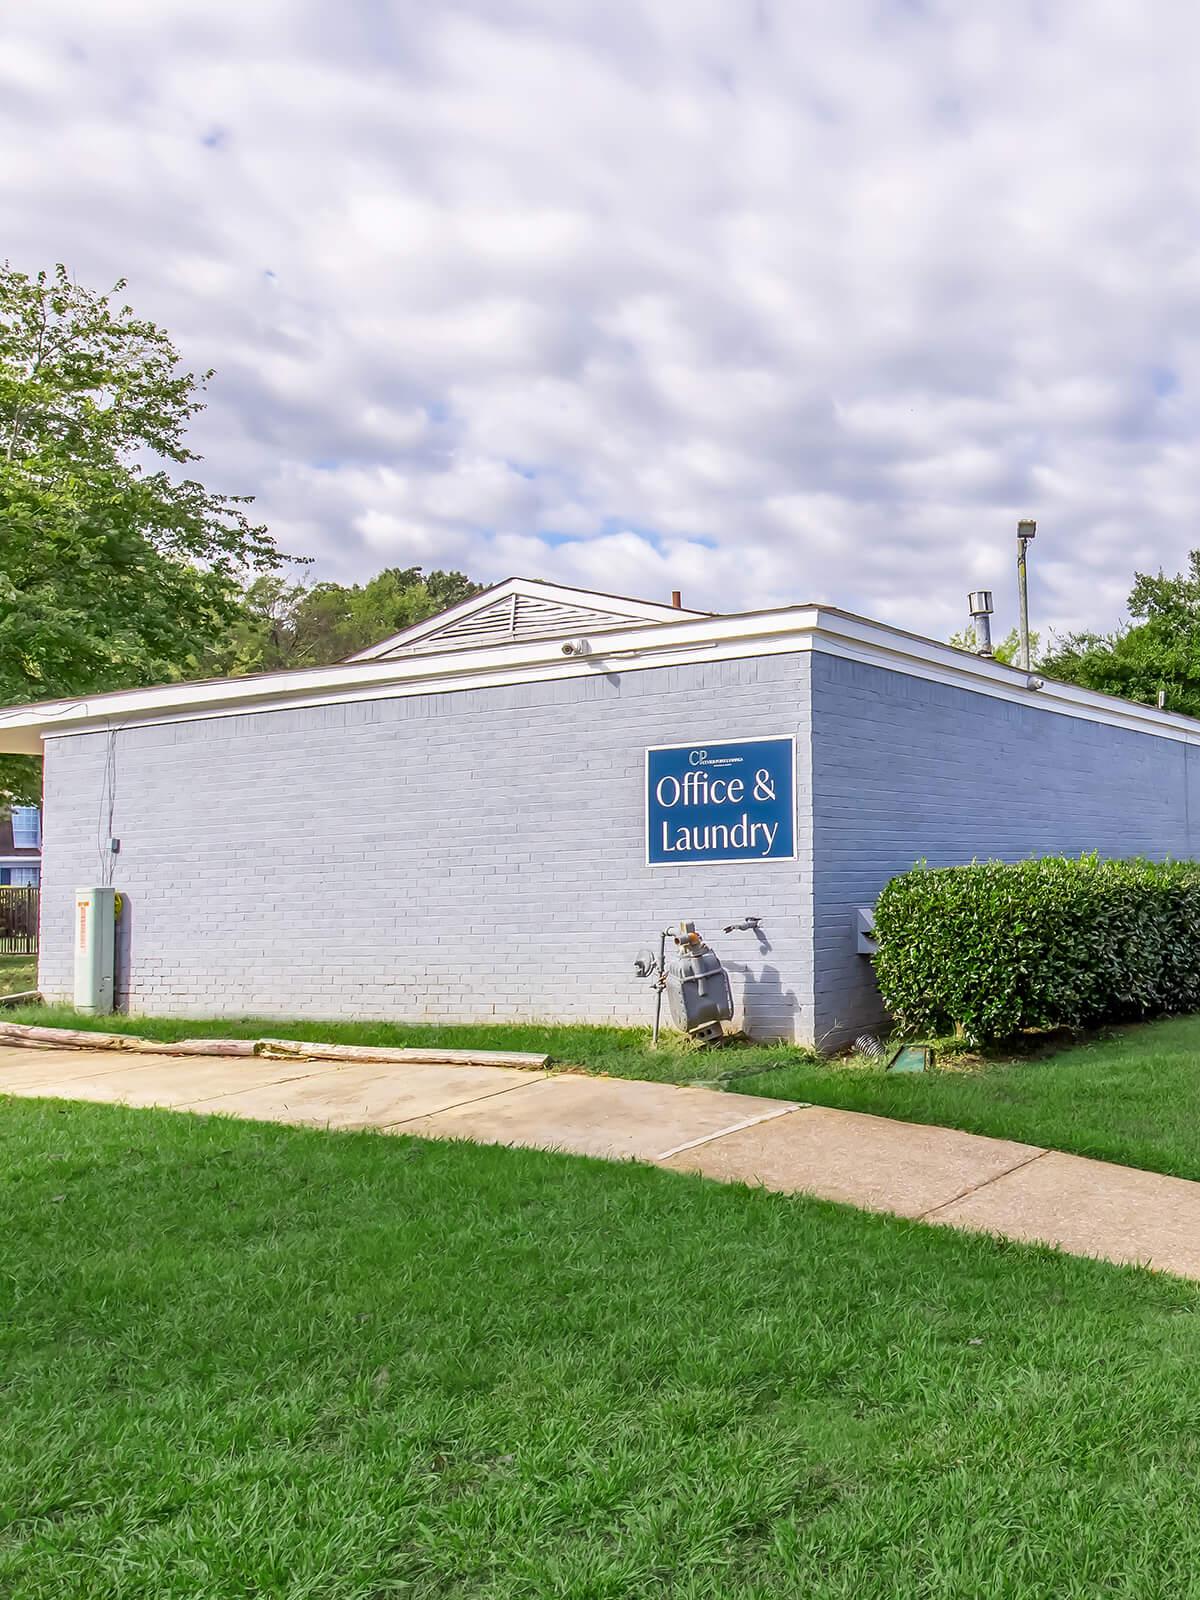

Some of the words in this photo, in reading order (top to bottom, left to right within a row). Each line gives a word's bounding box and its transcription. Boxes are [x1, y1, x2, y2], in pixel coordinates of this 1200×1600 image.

[656, 771, 744, 807] Office
[753, 768, 776, 801] &
[662, 813, 779, 856] Laundry
